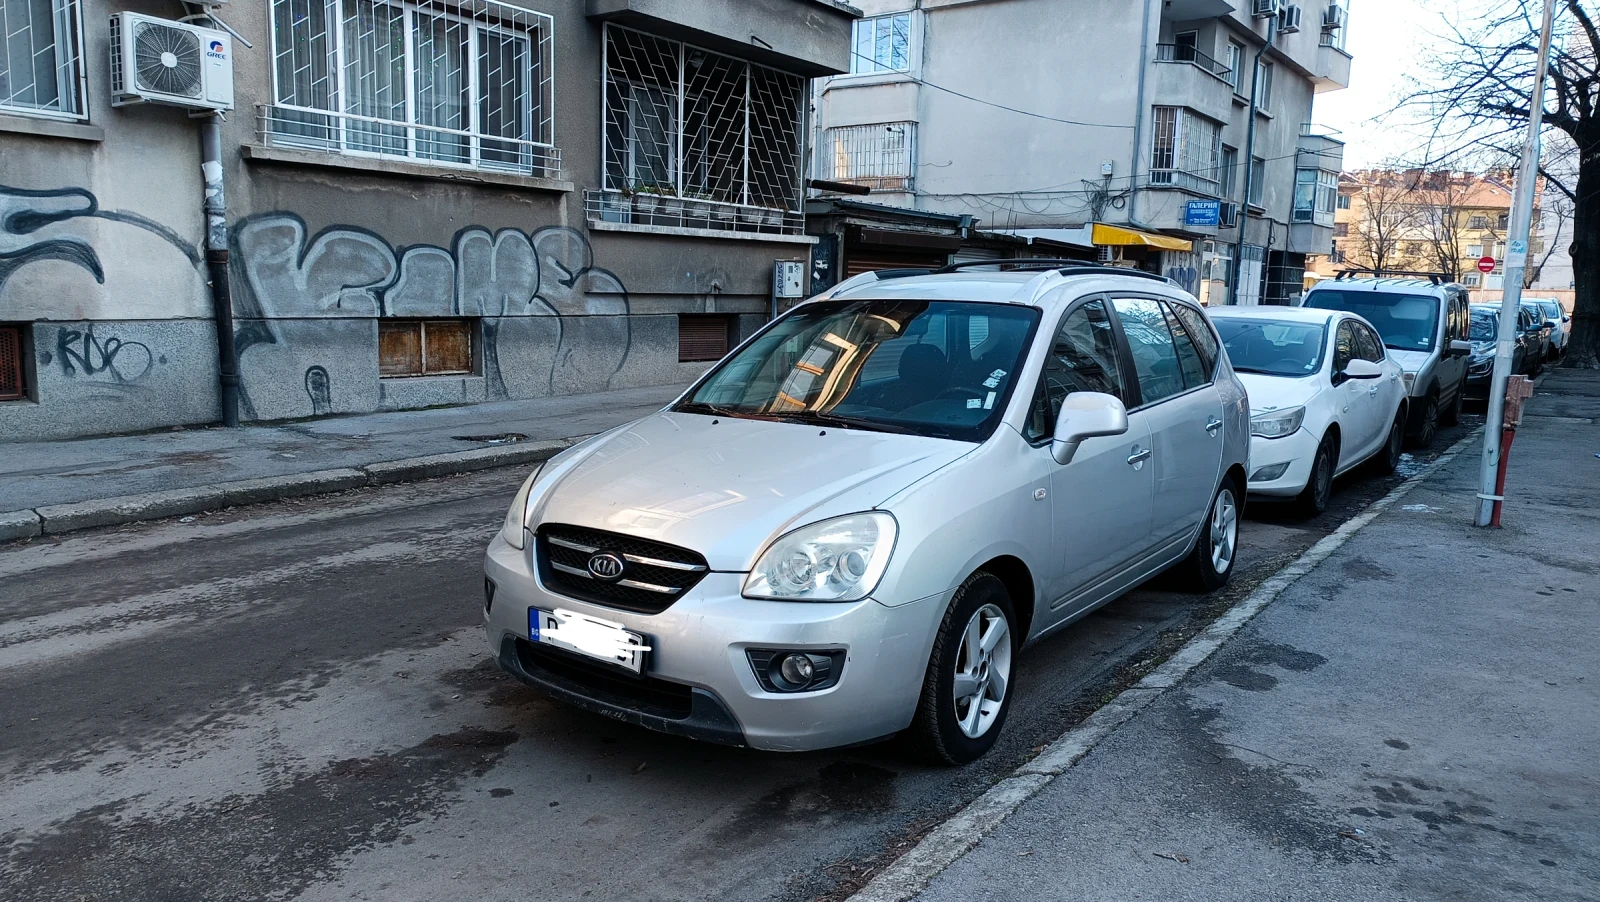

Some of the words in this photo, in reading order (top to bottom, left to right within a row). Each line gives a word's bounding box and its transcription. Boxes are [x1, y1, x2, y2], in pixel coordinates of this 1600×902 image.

[207, 52, 226, 60] GREE
[594, 558, 615, 575] KIA
[531, 628, 539, 636] BG
